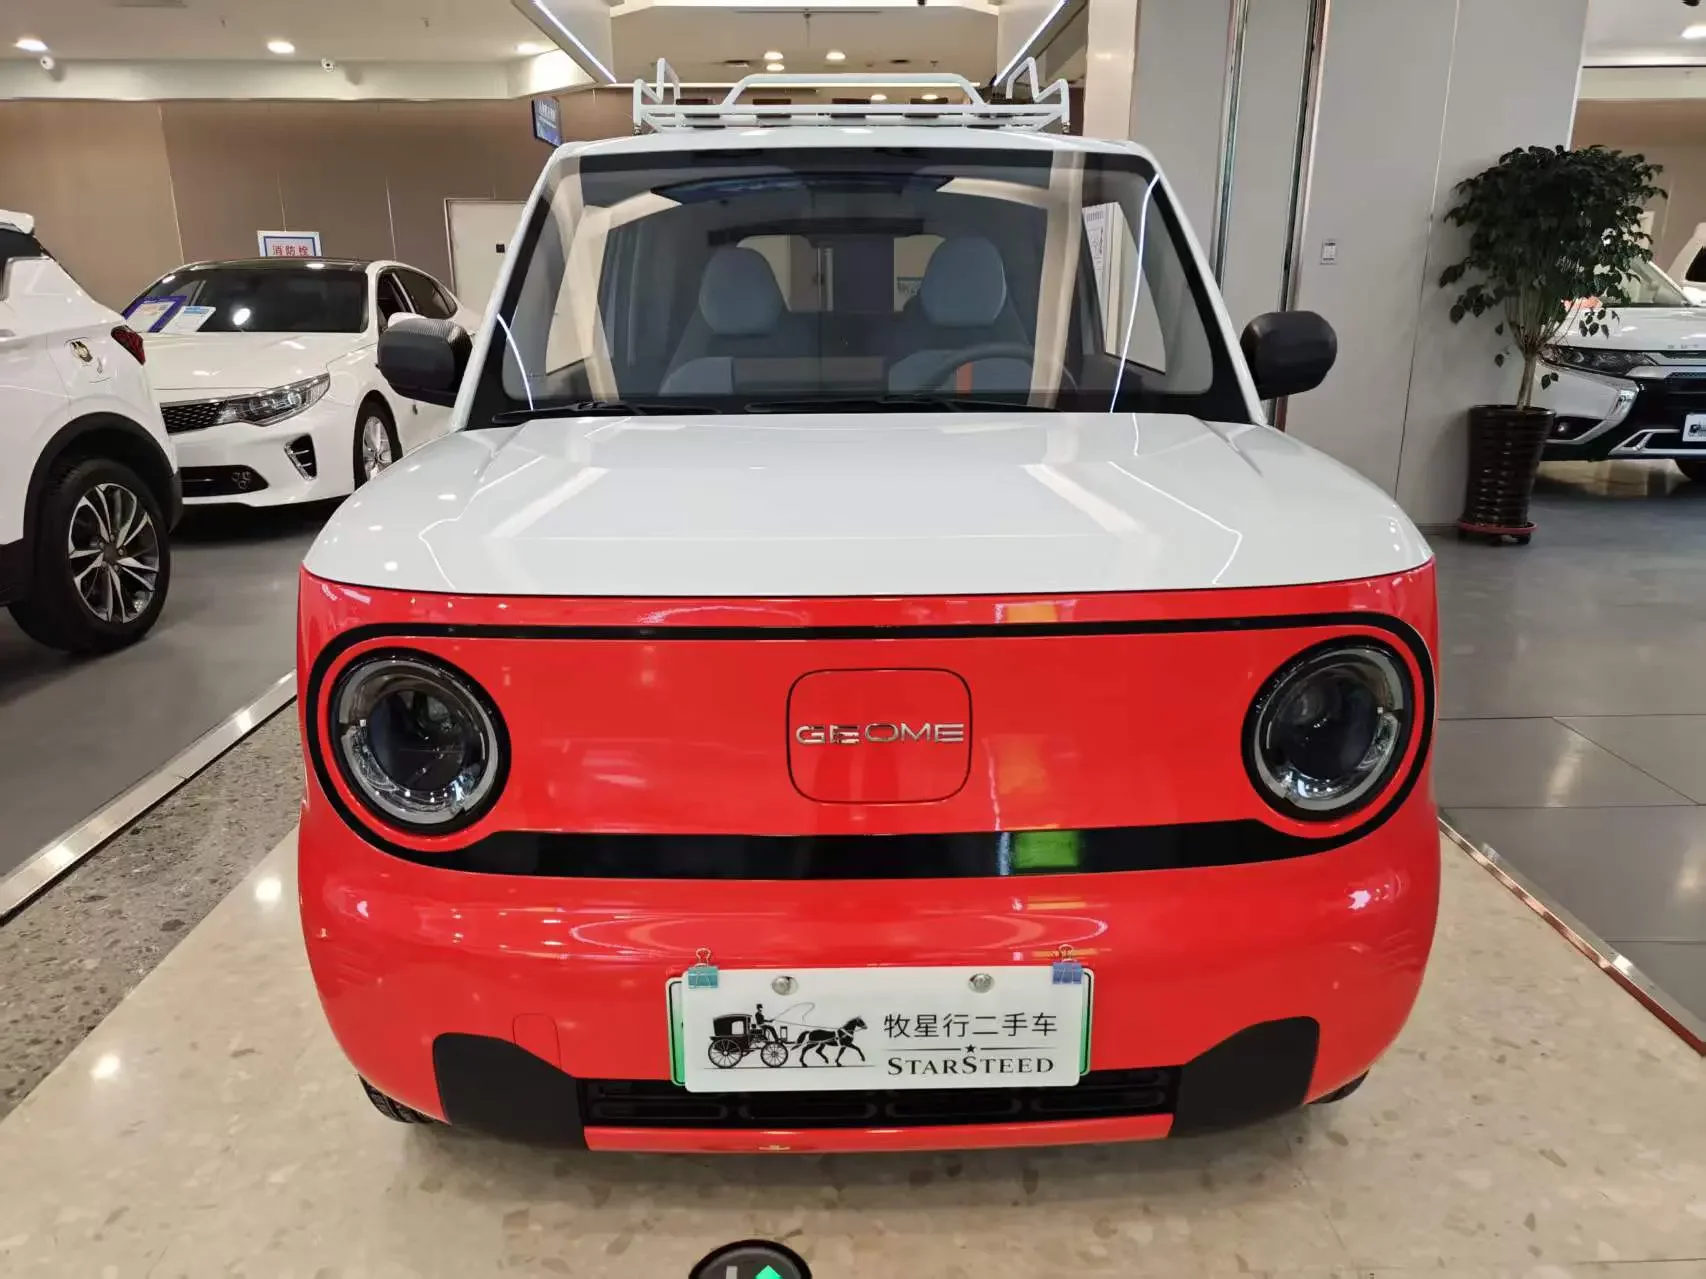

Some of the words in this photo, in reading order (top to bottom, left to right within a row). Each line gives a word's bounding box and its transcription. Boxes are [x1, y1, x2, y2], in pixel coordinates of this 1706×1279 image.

[272, 243, 309, 257] 消防栓
[795, 722, 964, 744] GEOME
[884, 1012, 1058, 1038] 牧星行二手车
